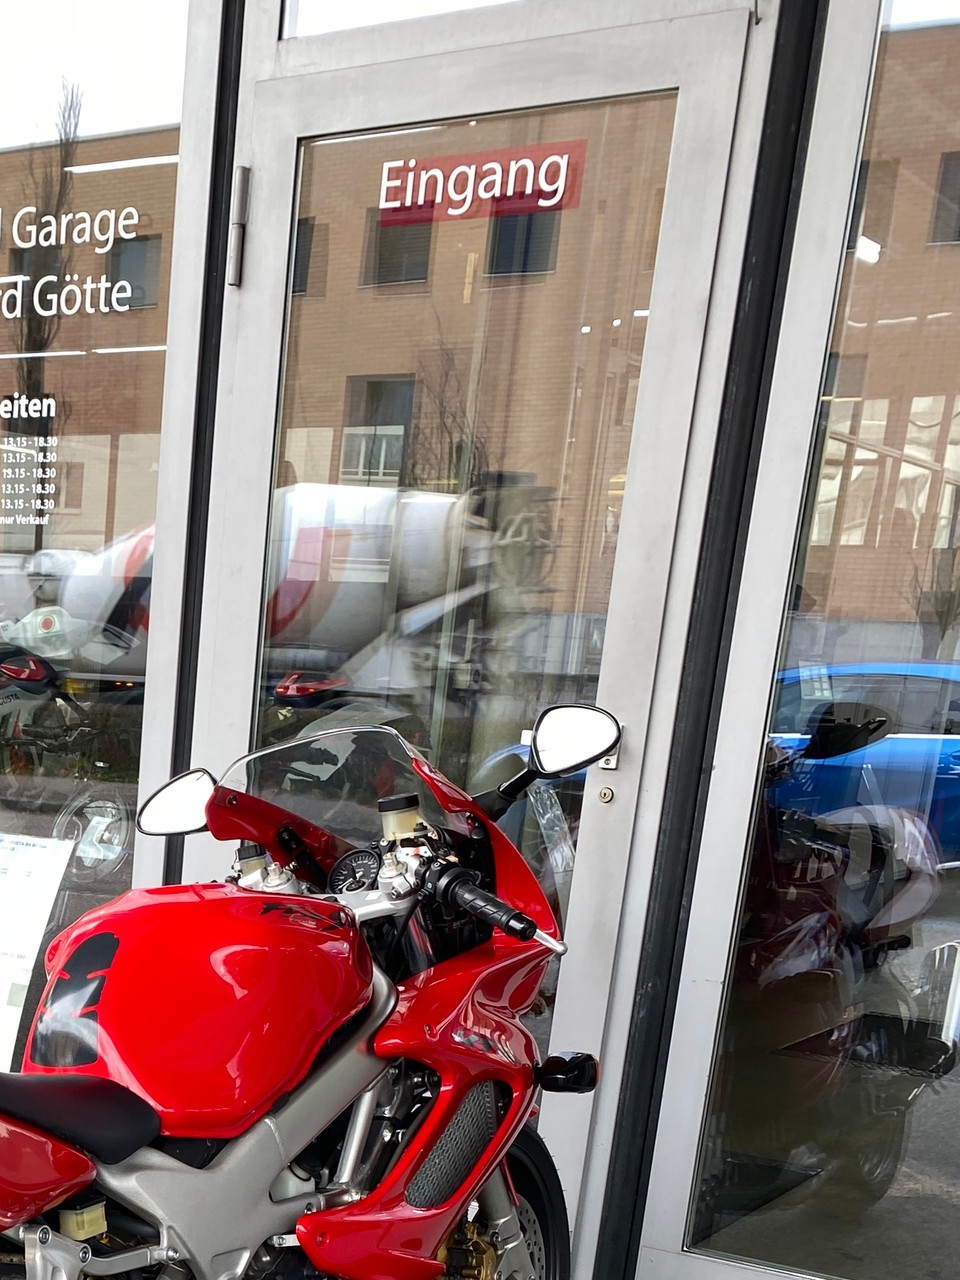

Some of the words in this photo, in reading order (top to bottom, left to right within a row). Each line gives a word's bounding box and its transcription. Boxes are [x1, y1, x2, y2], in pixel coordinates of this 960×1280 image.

[378, 153, 569, 216] Eingang
[12, 205, 139, 254] Garage
[33, 273, 132, 317] Götte
[4, 437, 27, 447] 13.15
[34, 437, 58, 447] 18.30
[3, 453, 26, 463] 13.15
[33, 452, 57, 463] 18.30
[2, 468, 25, 478] 13.15
[32, 468, 56, 478] 18.30
[1, 484, 25, 494] 13.15
[31, 483, 56, 494] 18.30
[1, 499, 24, 509] 13.15
[31, 499, 55, 509] 18.30
[0, 516, 15, 524] nur
[15, 514, 50, 525] Verkauf
